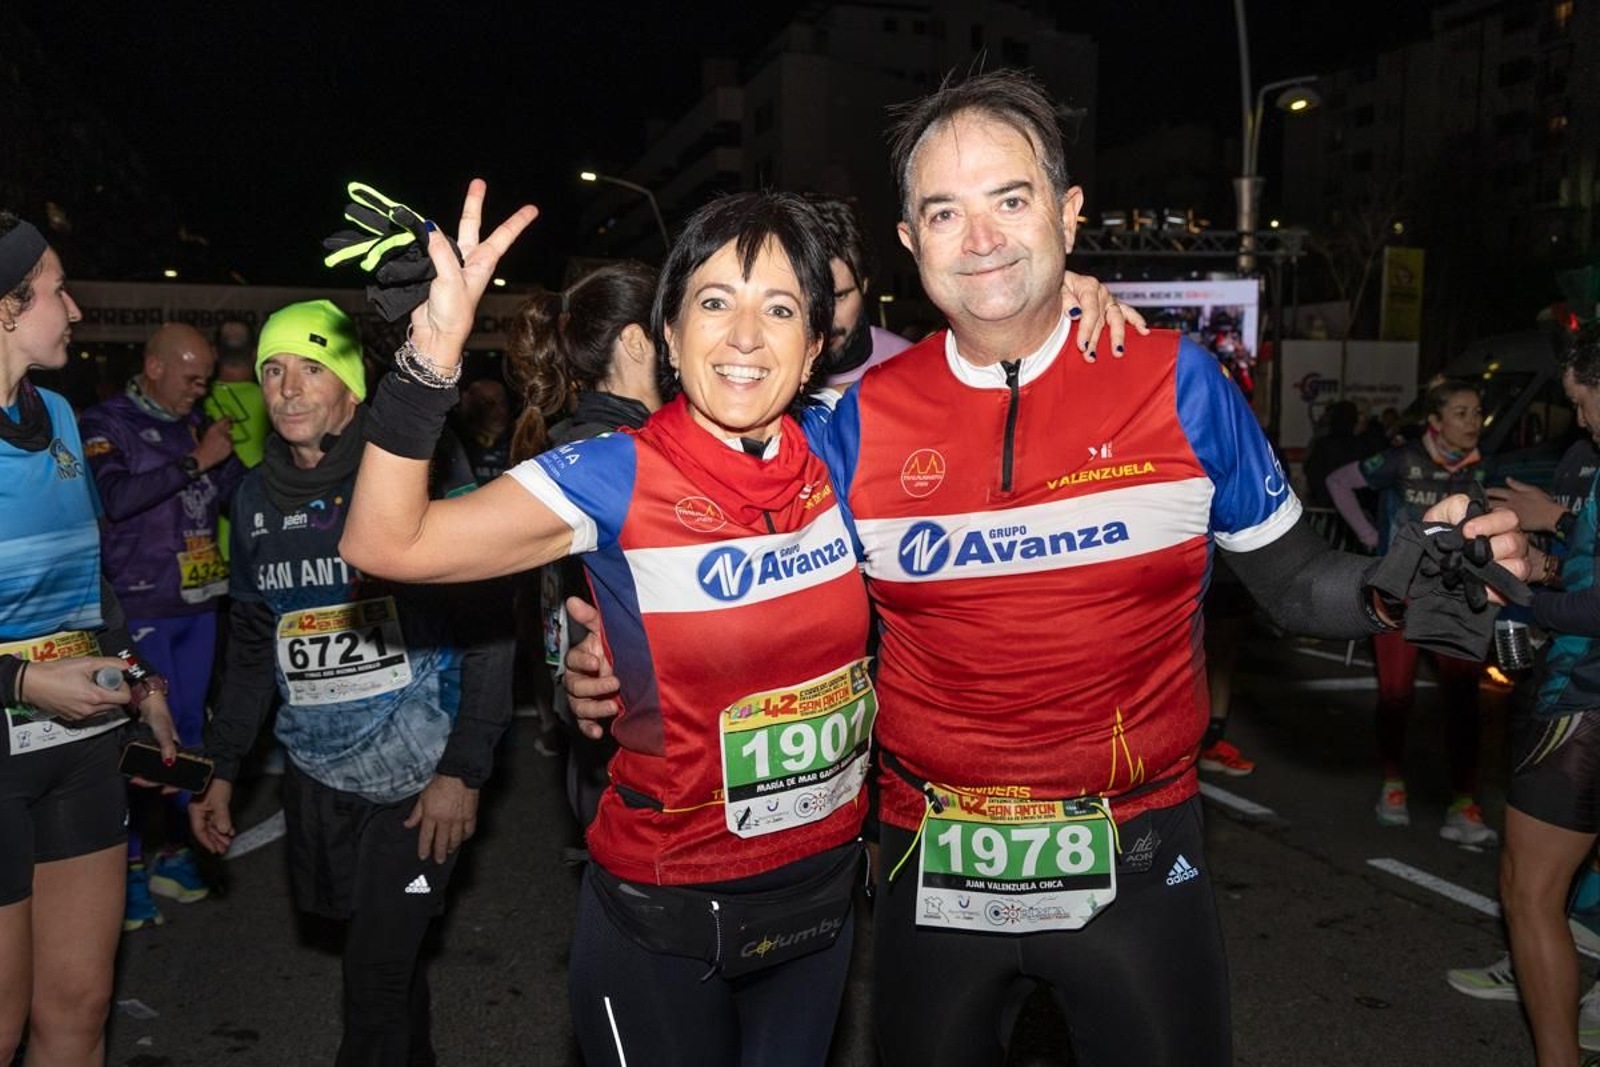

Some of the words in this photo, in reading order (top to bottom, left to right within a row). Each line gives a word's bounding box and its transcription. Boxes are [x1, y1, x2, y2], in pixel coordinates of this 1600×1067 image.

[1046, 461, 1156, 490] VALENZUELA
[1405, 489, 1437, 505] SAN
[282, 510, 308, 530] jaén
[989, 525, 1027, 540] GRUPO
[779, 543, 801, 558] GRUPO
[953, 520, 1130, 567] Avanza
[757, 537, 848, 585] Avanza
[257, 560, 294, 591] SAN
[301, 556, 350, 588] ANT
[31, 641, 58, 662] 42
[288, 626, 388, 670] 6721
[764, 693, 798, 718] 42
[799, 698, 822, 712] SAN
[741, 698, 867, 779] 1901
[756, 780, 785, 793] MARÍA
[786, 777, 797, 786] DE
[798, 773, 818, 784] MAR
[987, 805, 1010, 816] SAN
[1014, 803, 1056, 816] ANTON
[937, 824, 1096, 877] 1978
[965, 879, 986, 889] JUAN
[987, 880, 1037, 892] VALENZUELA
[1039, 880, 1064, 889] CHICA
[1166, 867, 1199, 886] adidas
